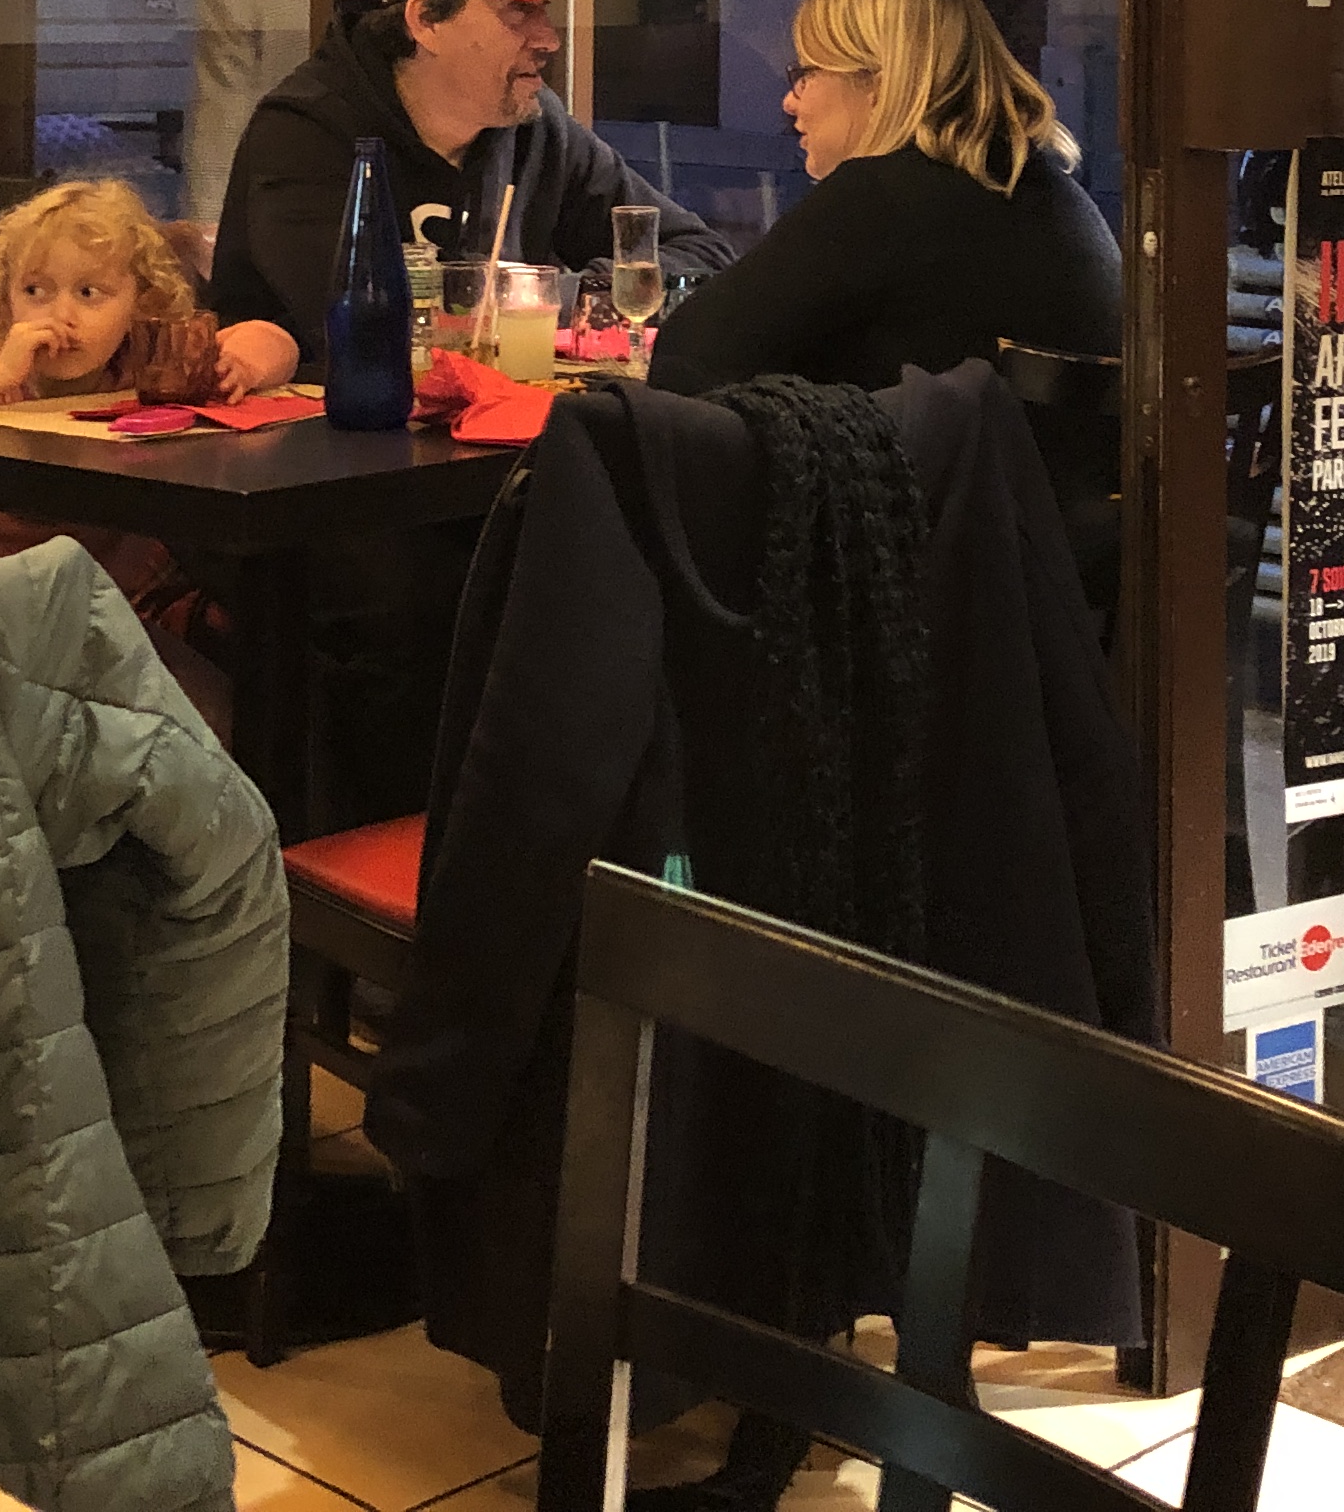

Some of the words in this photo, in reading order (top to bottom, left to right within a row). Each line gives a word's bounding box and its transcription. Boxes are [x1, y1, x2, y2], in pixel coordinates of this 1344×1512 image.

[1309, 569, 1319, 594] 7
[1309, 643, 1336, 664] 2019
[1260, 938, 1297, 961] Ticket
[1225, 955, 1297, 984] Restaurant
[1257, 1049, 1314, 1073] AMERICAN
[1267, 1067, 1317, 1089] EXPRESS
